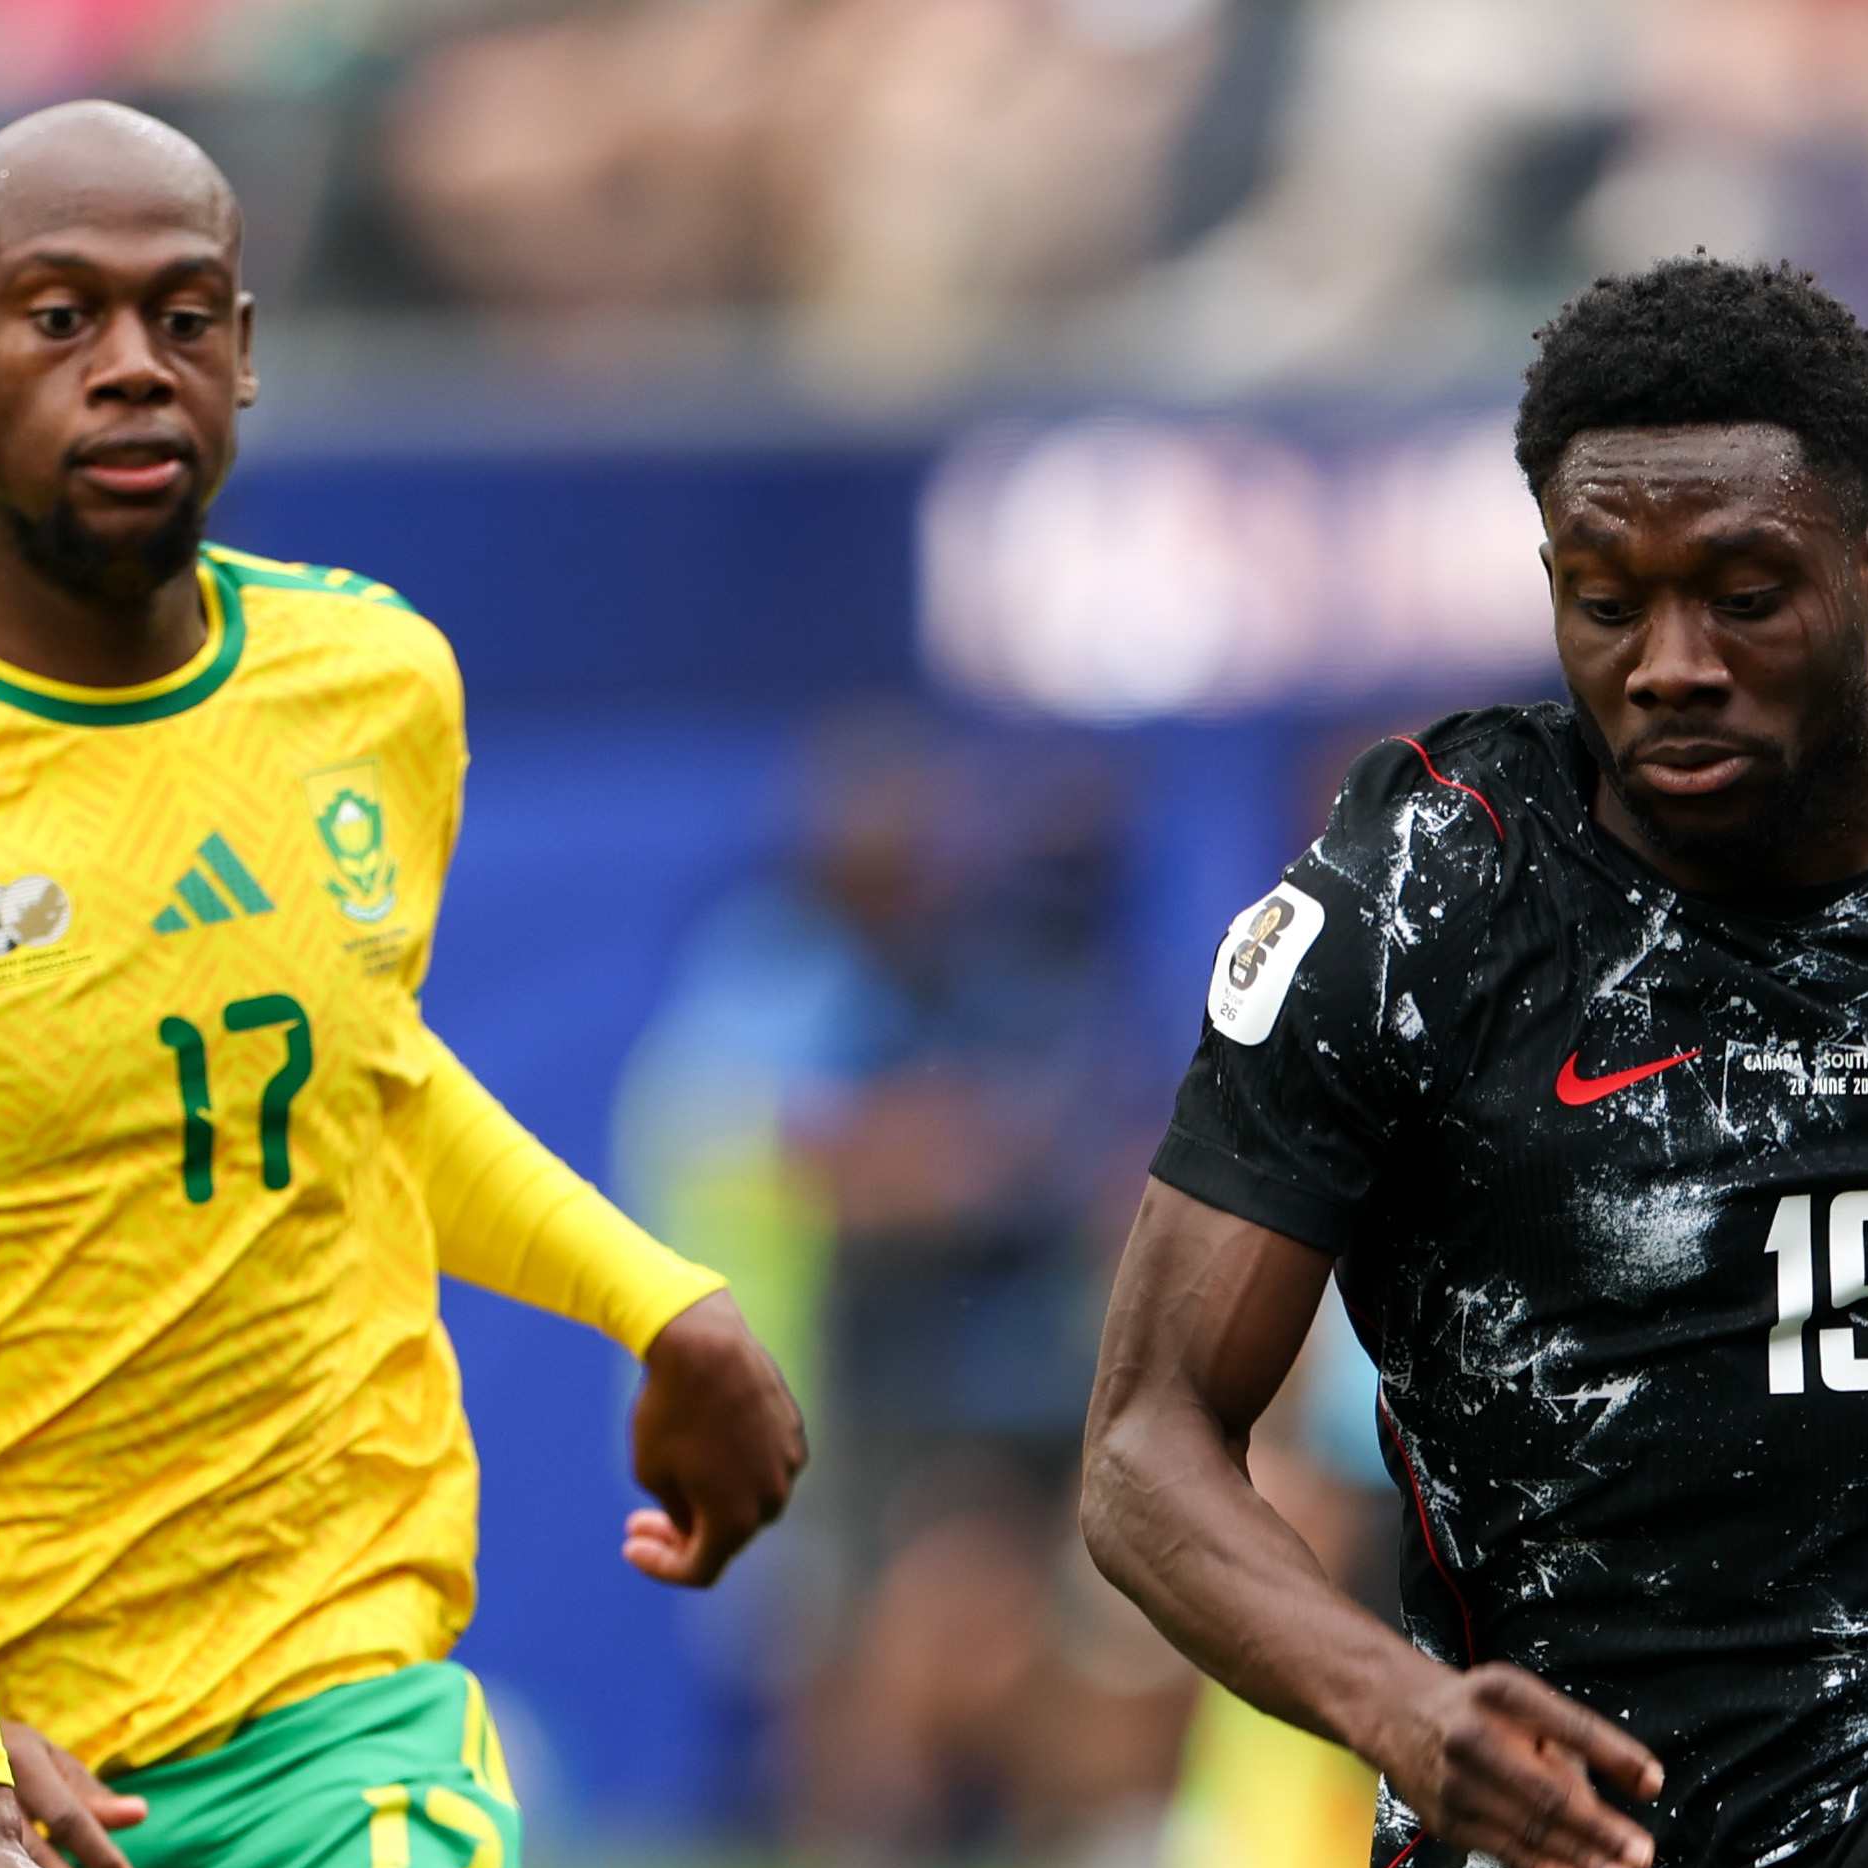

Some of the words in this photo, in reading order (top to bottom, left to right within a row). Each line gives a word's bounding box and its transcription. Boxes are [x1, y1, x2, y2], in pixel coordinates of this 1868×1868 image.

[1743, 1053, 1804, 1071] CANADA
[1789, 1078, 1806, 1096] 28
[1811, 1077, 1847, 1095] JUNE
[158, 993, 314, 1204] 17
